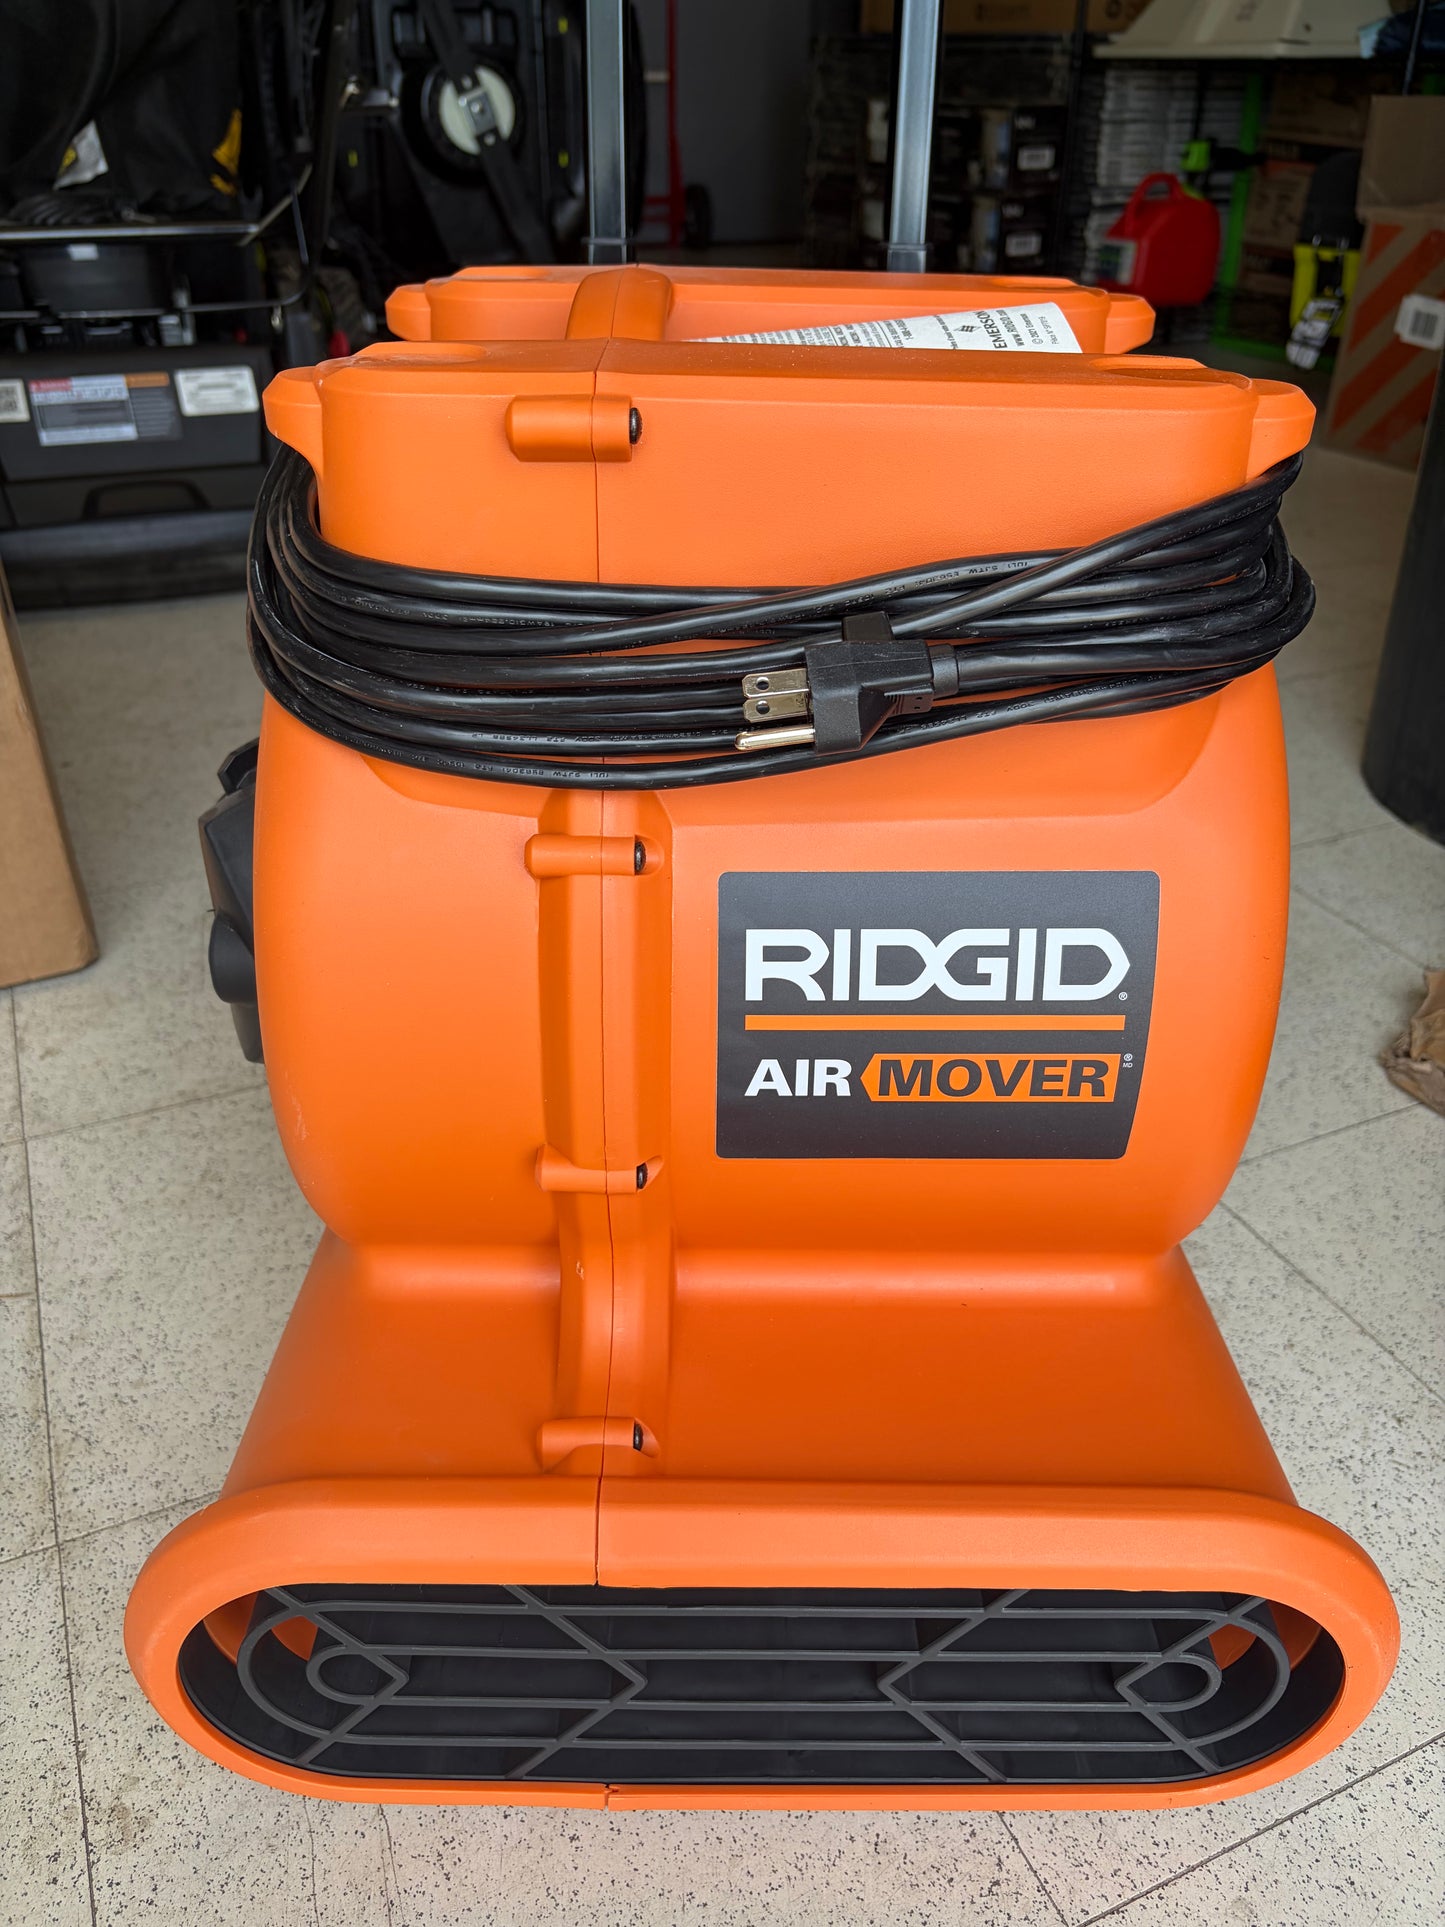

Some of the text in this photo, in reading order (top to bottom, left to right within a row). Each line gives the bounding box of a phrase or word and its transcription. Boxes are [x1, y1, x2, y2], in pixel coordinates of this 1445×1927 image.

[968, 565, 999, 574] SJTW
[744, 1059, 853, 1096] AIR
[878, 1059, 1109, 1097] MOVER
